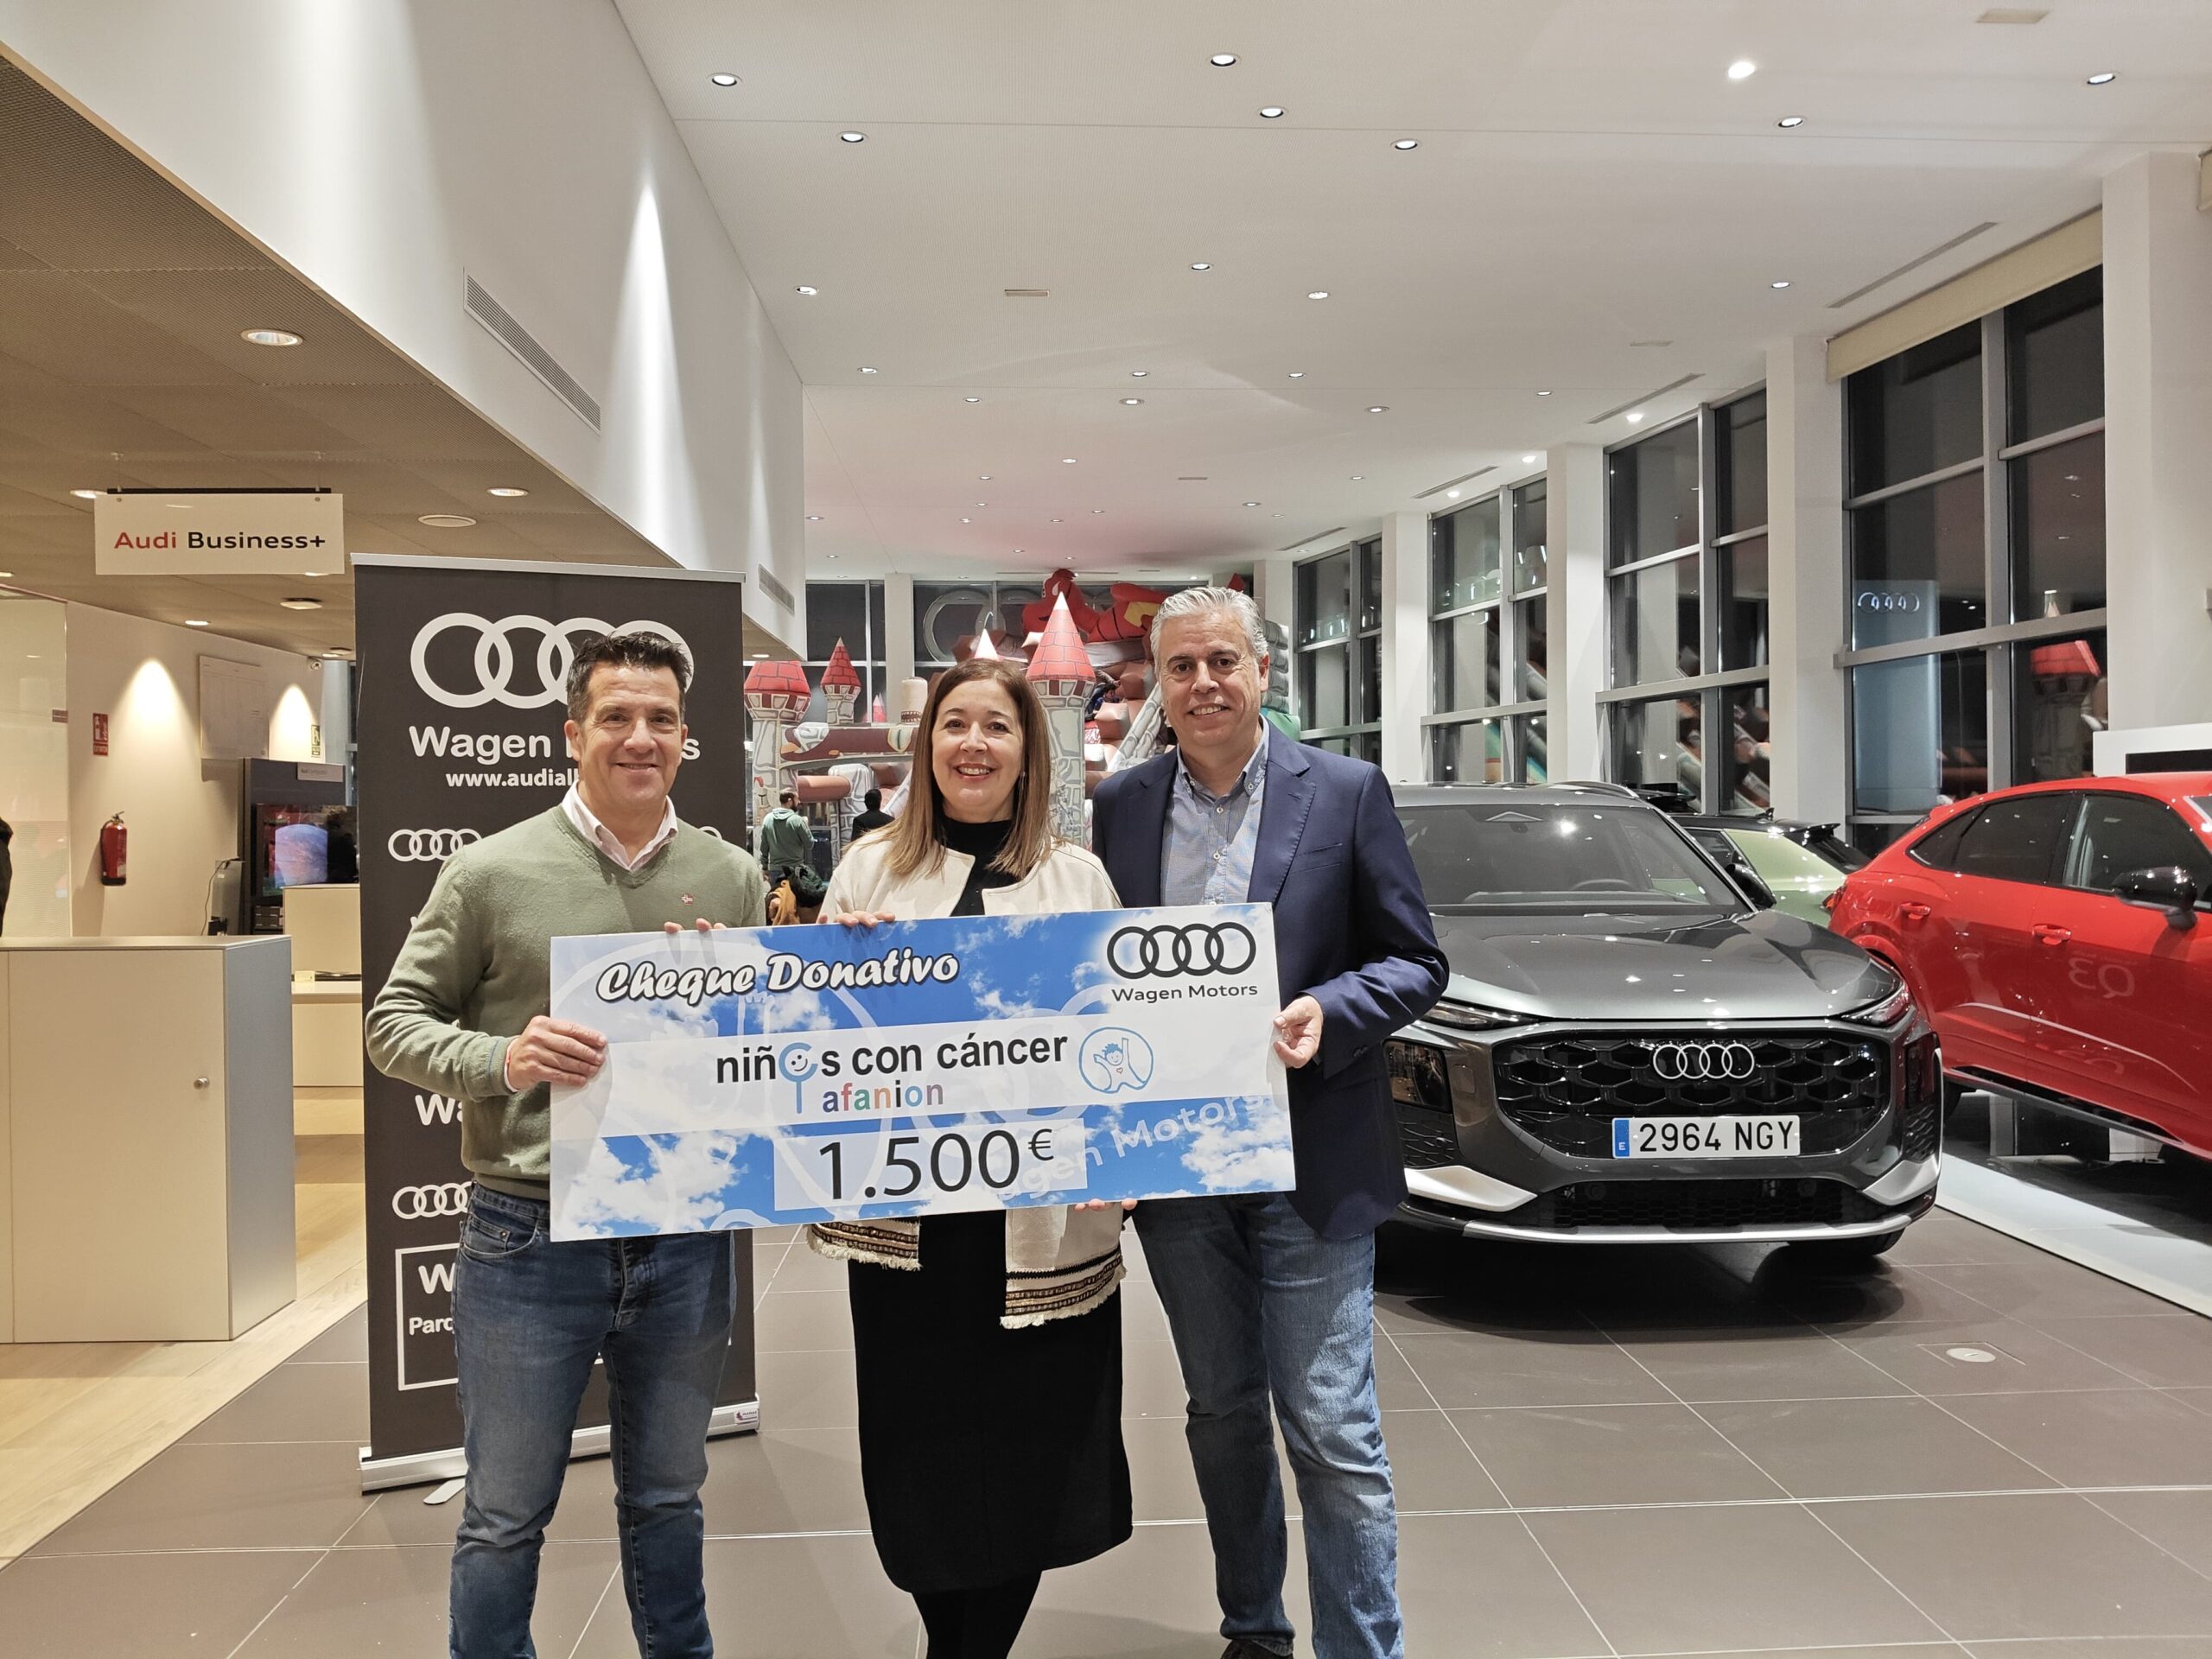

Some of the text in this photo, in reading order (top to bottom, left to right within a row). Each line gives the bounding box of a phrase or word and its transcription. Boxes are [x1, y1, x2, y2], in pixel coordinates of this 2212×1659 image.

[114, 531, 326, 549] Audi Business+
[409, 726, 551, 765] Wagen
[596, 947, 960, 1006] Cheque Donativo
[1111, 984, 1258, 1004] Wagen Motors
[852, 1043, 922, 1076] con
[938, 1033, 1068, 1070] cáncer
[823, 1080, 944, 1113] afanion
[1639, 1122, 1721, 1152] 2964
[1735, 1121, 1794, 1151] NGY
